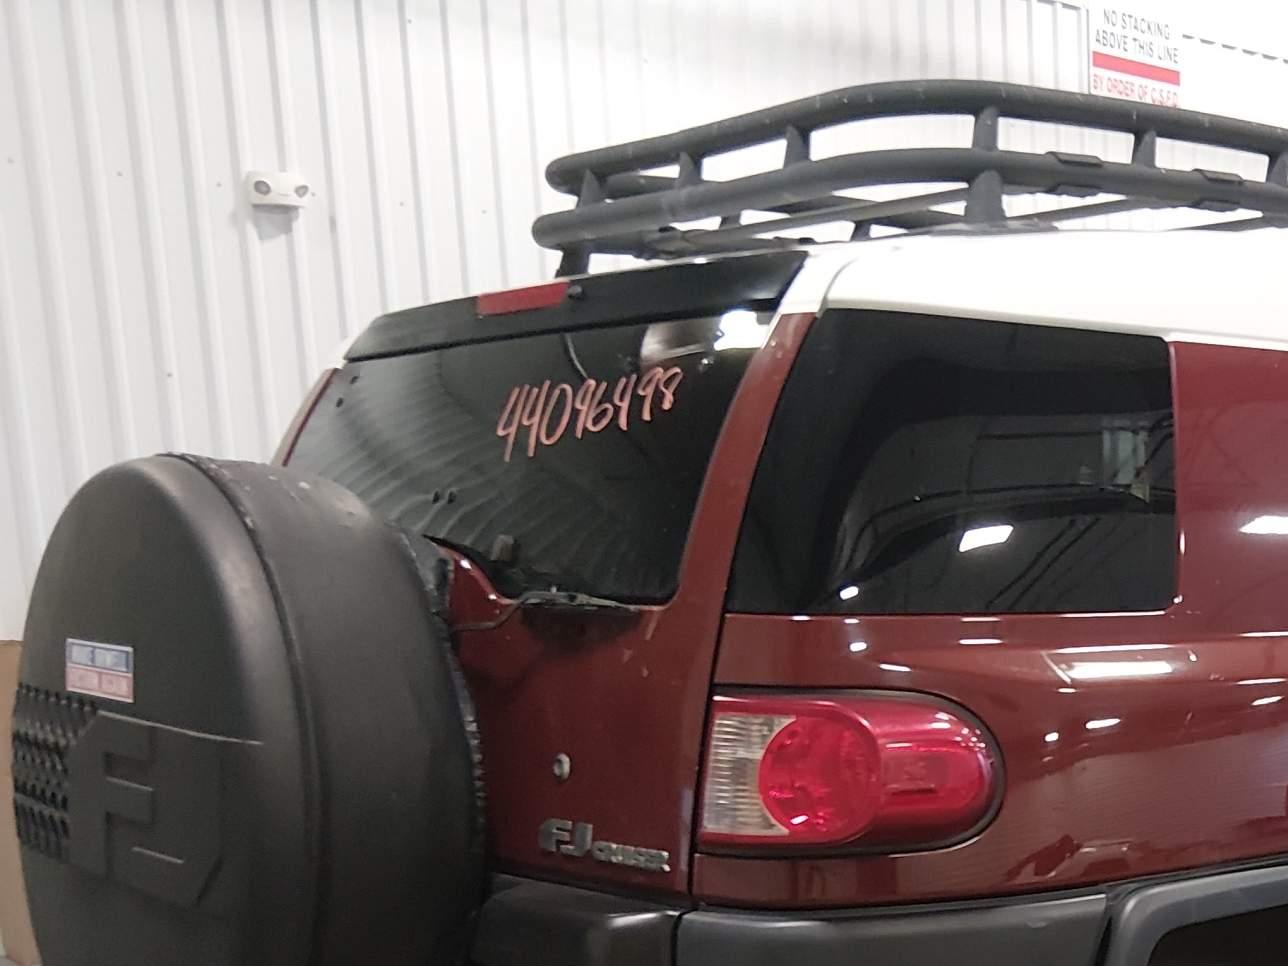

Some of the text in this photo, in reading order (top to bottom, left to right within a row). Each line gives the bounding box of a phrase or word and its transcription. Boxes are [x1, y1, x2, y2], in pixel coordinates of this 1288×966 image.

[1103, 8, 1170, 40] NO STACKING
[1095, 29, 1179, 64] ABOVE THIS LINE
[496, 366, 684, 463] 44096498
[539, 818, 593, 857] FJ
